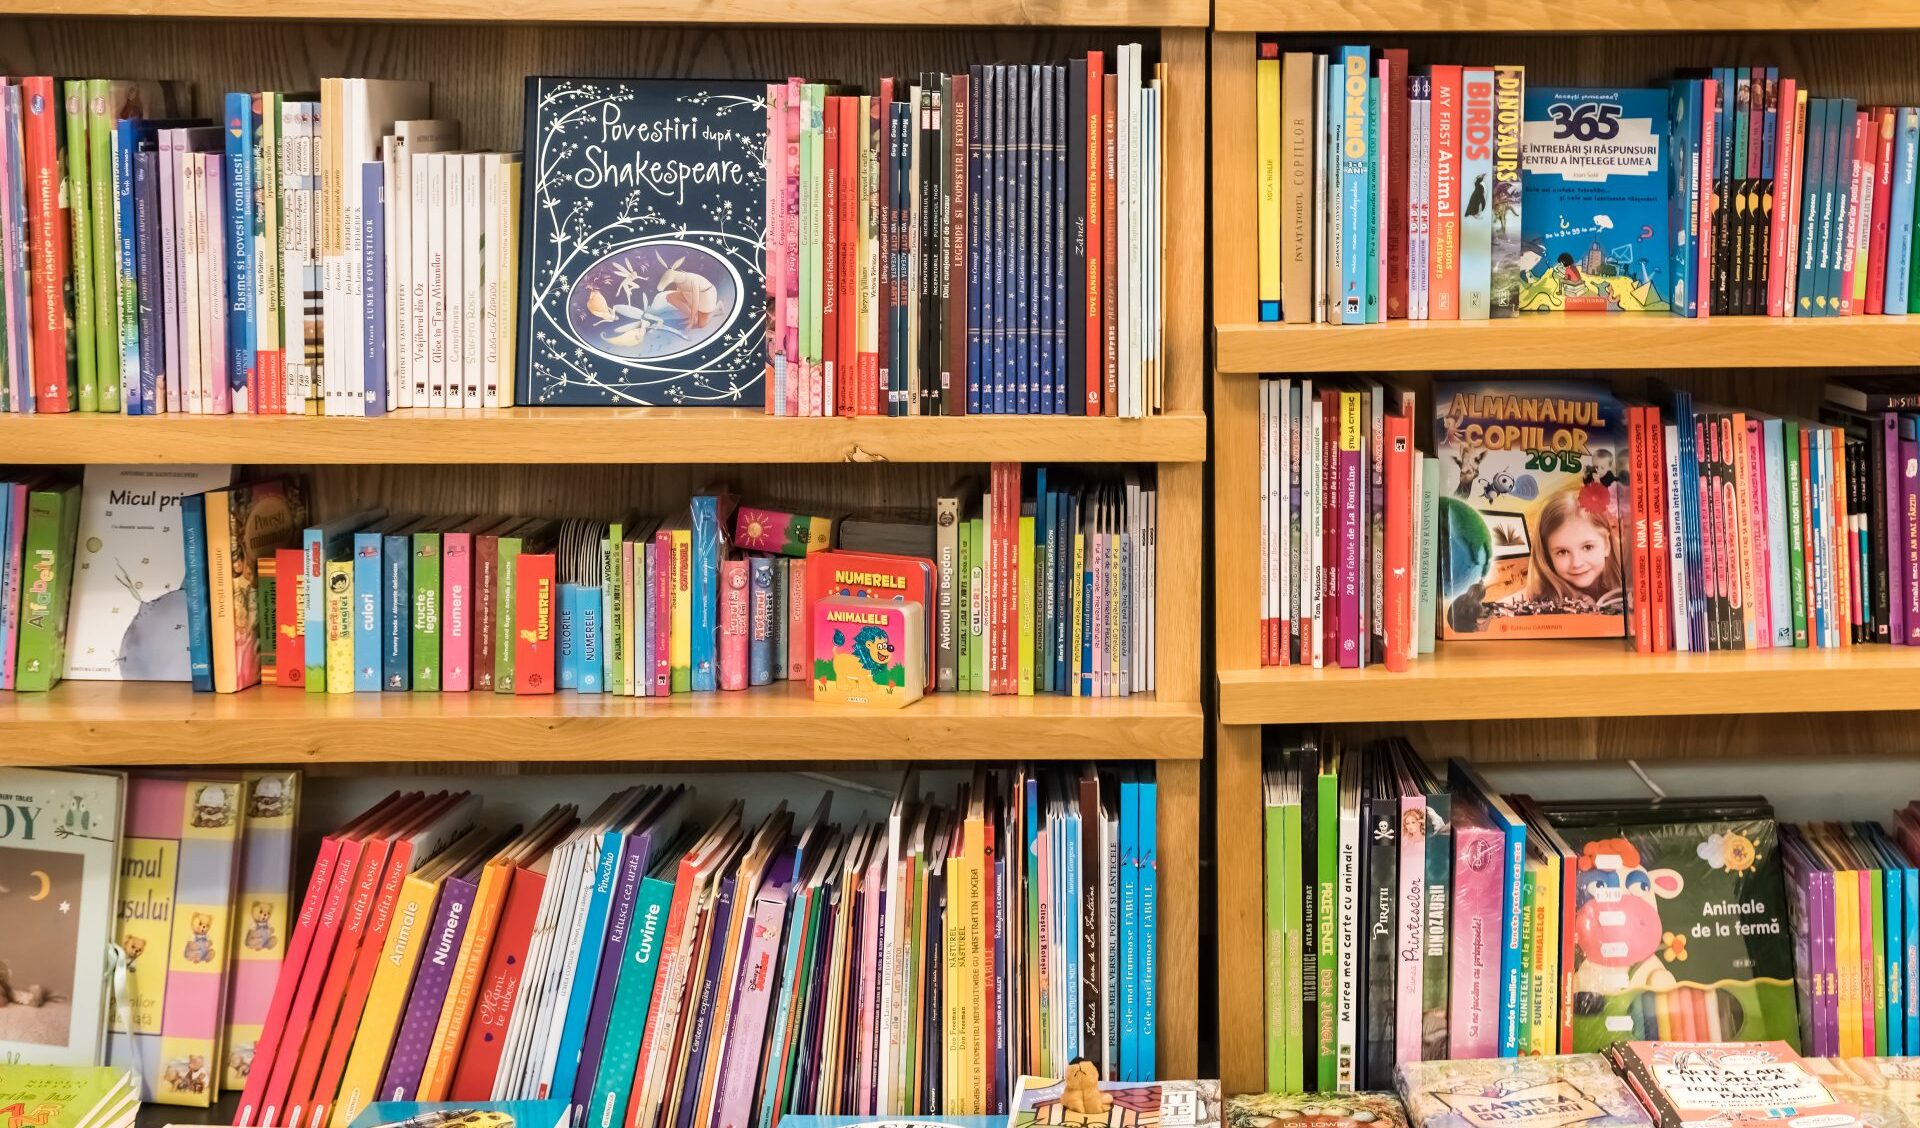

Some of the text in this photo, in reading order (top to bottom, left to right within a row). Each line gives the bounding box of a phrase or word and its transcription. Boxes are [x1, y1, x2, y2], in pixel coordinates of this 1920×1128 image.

[602, 102, 732, 150] Povestiri după
[1346, 56, 1365, 158] DOKEO
[1466, 82, 1490, 160] BIRDS
[1548, 103, 1622, 141] 365
[1496, 78, 1519, 180] DINOSAURS
[1530, 143, 1656, 156] ÎNTREBĂRI ȘI RĂSPUNSURI
[1294, 118, 1304, 185] COPIILOR
[1438, 86, 1452, 217] MY FIRST Animal
[1521, 156, 1559, 164] PENTRU
[1569, 156, 1615, 167] ÎNȚELEGE
[1618, 157, 1652, 165] LUMEA
[40, 167, 52, 218] animale
[575, 145, 742, 206] Shakespeare
[827, 169, 835, 198] România
[1088, 171, 1097, 181] ÎN
[44, 222, 53, 236] cu
[827, 207, 836, 243] germanilor
[955, 222, 964, 266] LEGENDE
[1075, 216, 1084, 256] Zânele
[1805, 194, 1817, 269] Bogdan-Lorin Popescu
[46, 240, 56, 281] clasice
[366, 220, 374, 281] POVEȘTILOR
[942, 195, 951, 298] Dini, curajosul pui de dinozaur
[1444, 222, 1454, 270] Questions
[234, 273, 246, 310] Basme
[415, 283, 424, 296] Oz
[1347, 425, 1355, 434] SĂ
[1449, 393, 1606, 427] ALMANAHUL
[1465, 424, 1591, 456] COPIILOR
[1525, 448, 1582, 473] 2015
[1670, 456, 1678, 477] sat...
[110, 490, 183, 512] Micul pri
[1347, 465, 1356, 595] 20 de fabule de La Fontaine
[1638, 519, 1647, 548] NINA
[1674, 538, 1682, 558] Baba
[28, 550, 54, 629] Alfabetul
[836, 570, 906, 589] NUMERELE
[941, 547, 953, 650] Avionul lui Bogdan
[362, 594, 374, 630] culori
[414, 594, 425, 629] fructe
[425, 590, 435, 633] legume
[452, 585, 461, 636] numere
[539, 579, 549, 640] NUMERELE
[827, 611, 888, 625] ANIMALELE
[562, 611, 571, 656] CULORILE
[585, 611, 594, 661] NUMERELE
[598, 852, 615, 893] Pinocchio
[1107, 843, 1117, 894] CÂNTECELE
[300, 859, 330, 926] Alba ca Zapada
[619, 884, 631, 900] cea
[1703, 900, 1765, 917] Animale
[389, 902, 419, 966] Animale
[432, 903, 463, 965] Numere
[635, 905, 662, 963] Cuvinte
[1109, 907, 1117, 937] POEZII
[1341, 844, 1352, 1021] Marea mea carte cu animale
[1427, 885, 1445, 956] DINOZAURII
[1692, 917, 1780, 938] de la fermă
[948, 926, 956, 967] NĂSTUREL
[1109, 940, 1117, 980] VERSURI,
[1125, 882, 1134, 1032] Cele mai frumoase FABULE
[1522, 942, 1529, 952] la
[1522, 956, 1529, 968] de
[1533, 906, 1545, 1025] SUNETELE ANIMALELOR
[493, 977, 517, 1025] te iubesc
[1520, 972, 1528, 1023] SUNETELE
[1109, 1008, 1117, 1046] PRIMELE
